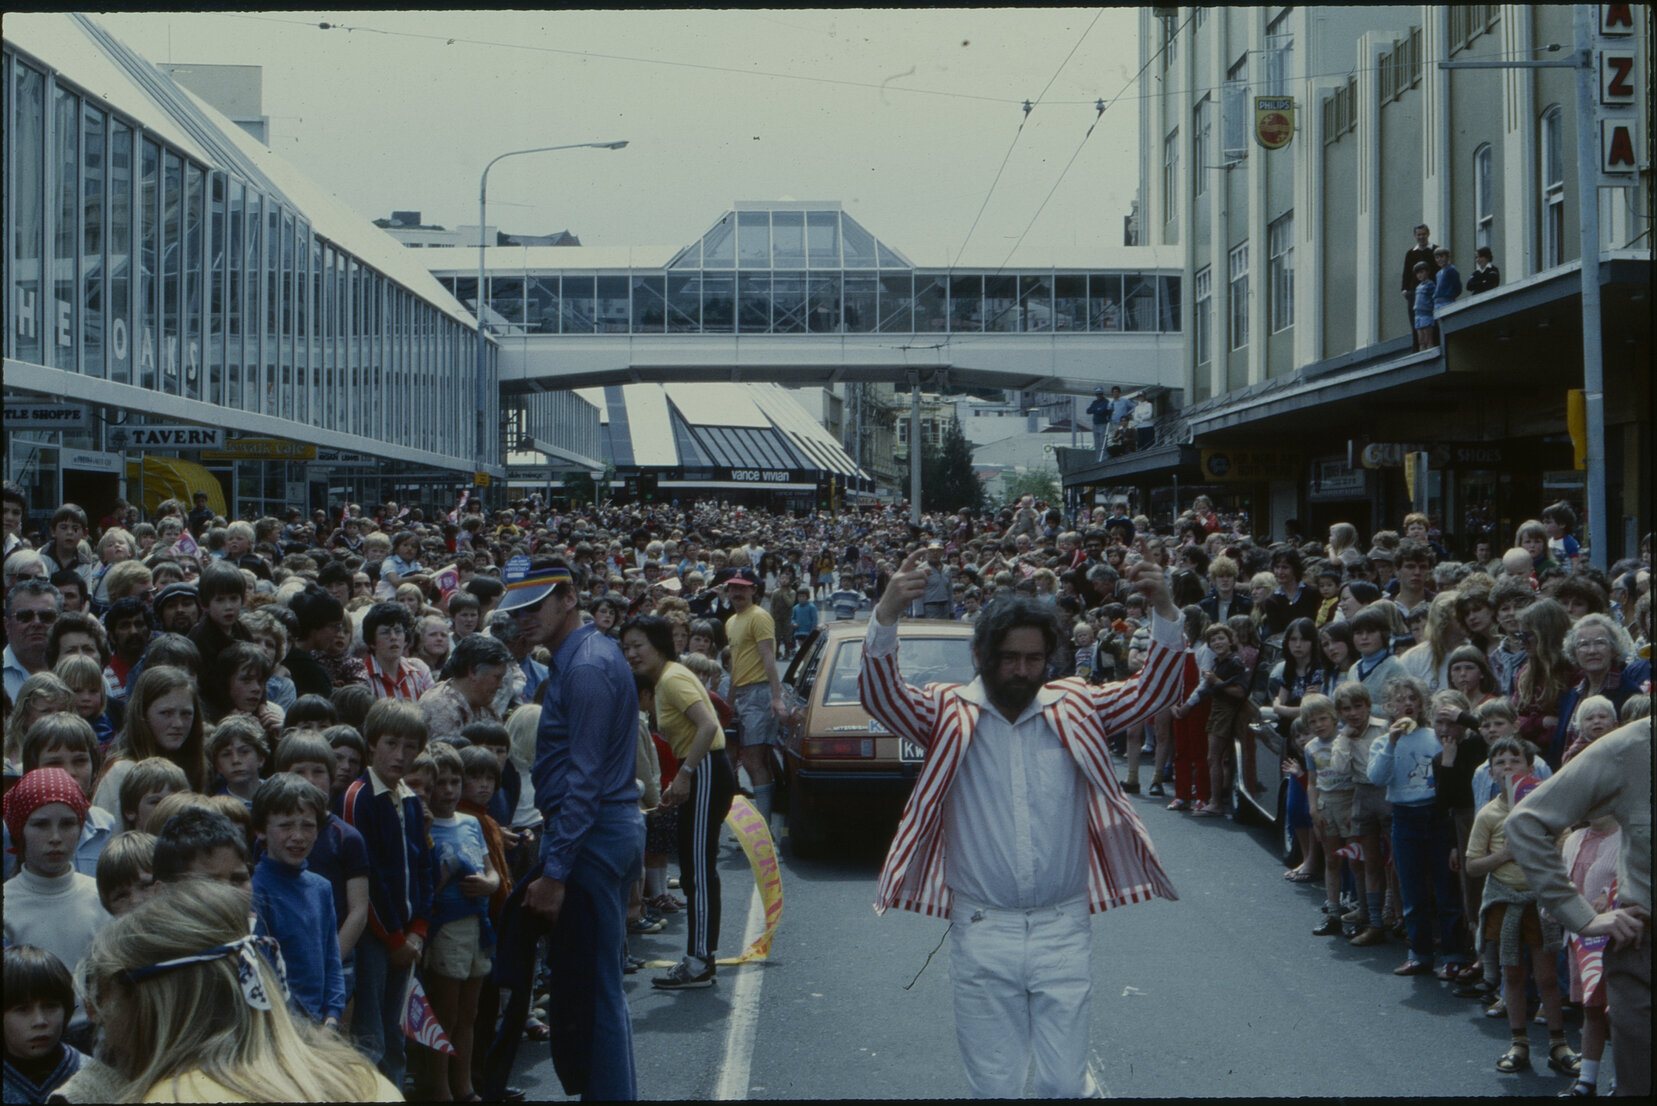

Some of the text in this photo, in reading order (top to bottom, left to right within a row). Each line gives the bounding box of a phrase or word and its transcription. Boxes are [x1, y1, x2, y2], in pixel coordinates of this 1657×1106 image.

[1259, 101, 1290, 110] PHILIPS
[113, 318, 199, 380] OAKS
[32, 410, 81, 420] SHOPPE
[133, 430, 216, 444] TAVERN
[1457, 448, 1503, 463] SHOES
[731, 469, 790, 482] vance vivian
